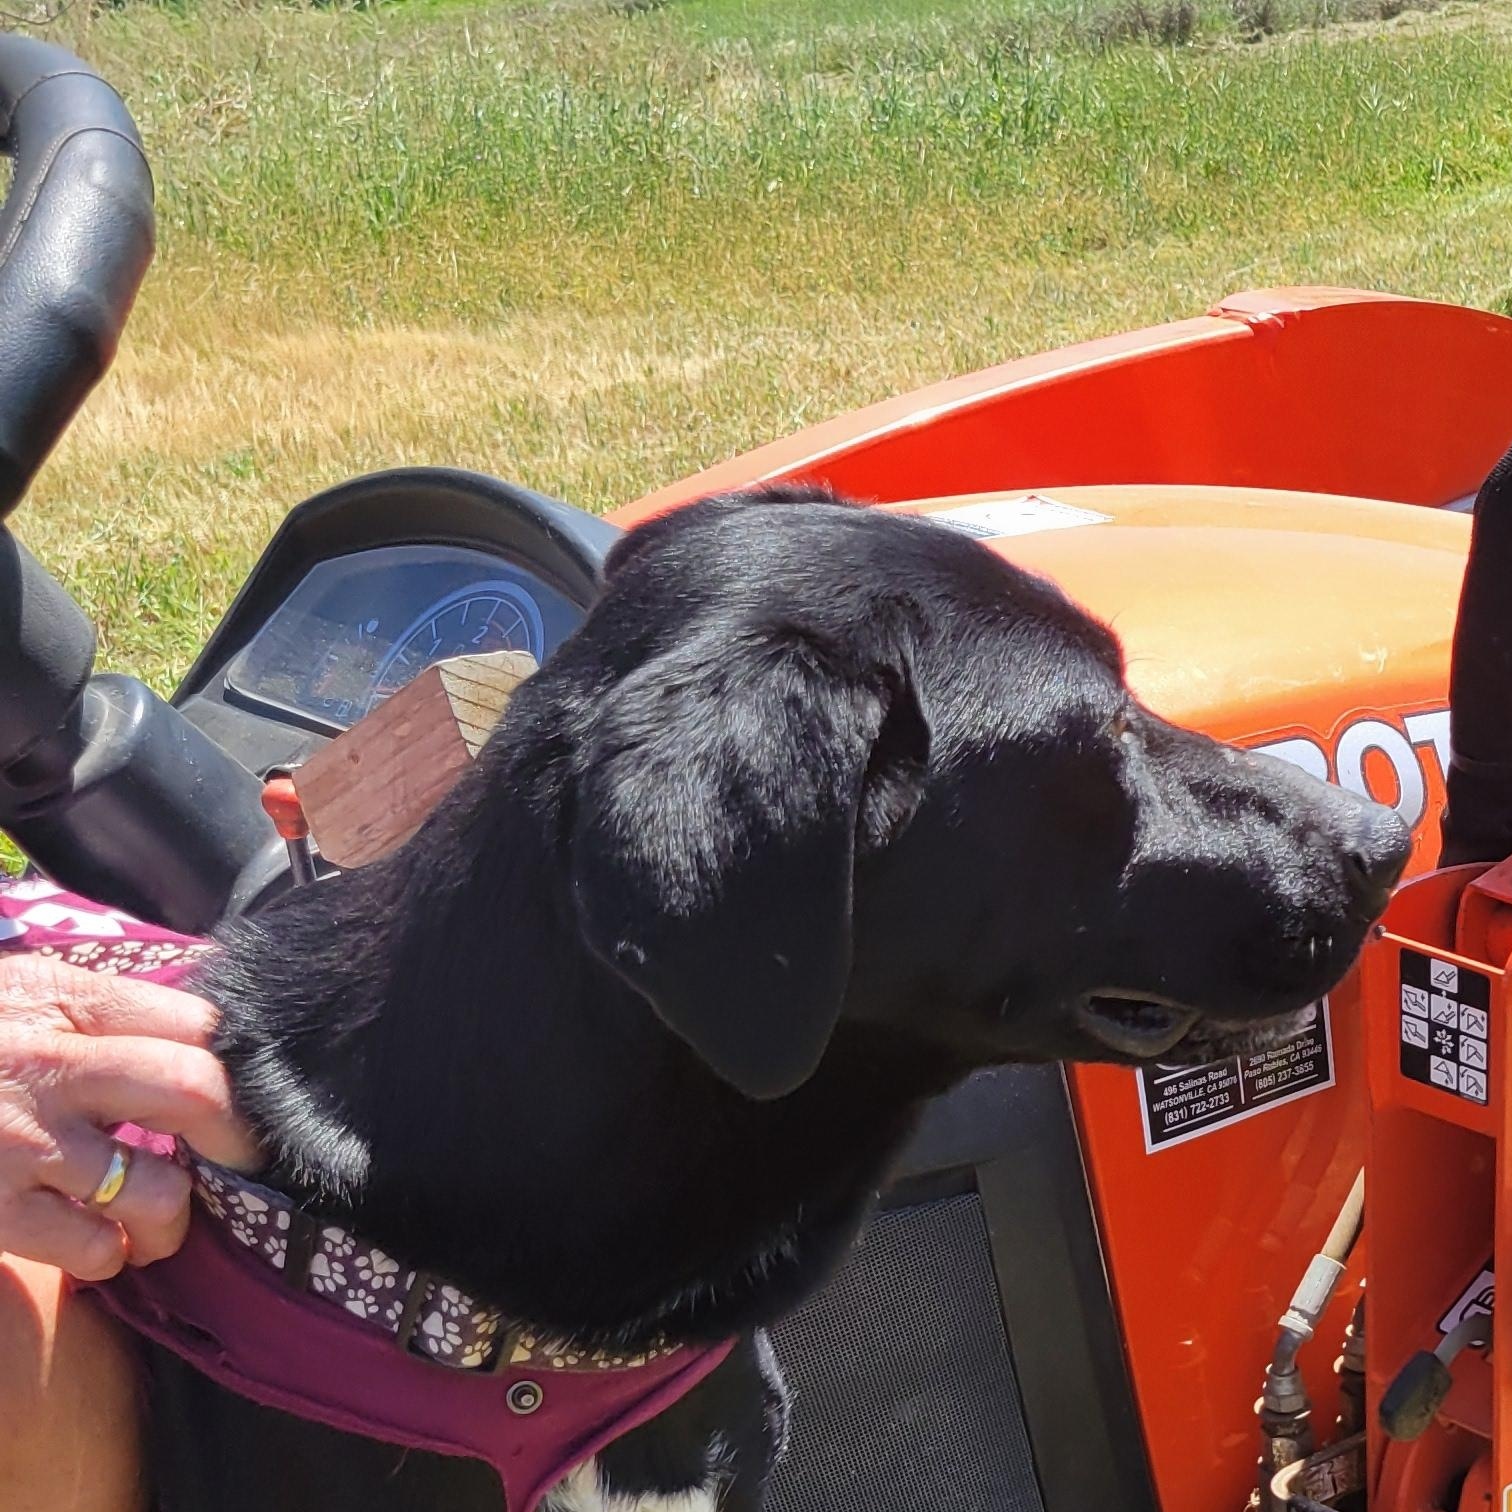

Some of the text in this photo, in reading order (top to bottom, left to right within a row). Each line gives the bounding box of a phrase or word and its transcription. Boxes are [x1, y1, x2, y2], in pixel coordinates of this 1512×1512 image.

[1290, 1052, 1300, 1063] CA
[1208, 1068, 1228, 1082] Road
[1207, 1083, 1218, 1094] CA
[1164, 1092, 1230, 1126] (831) 722-2733
